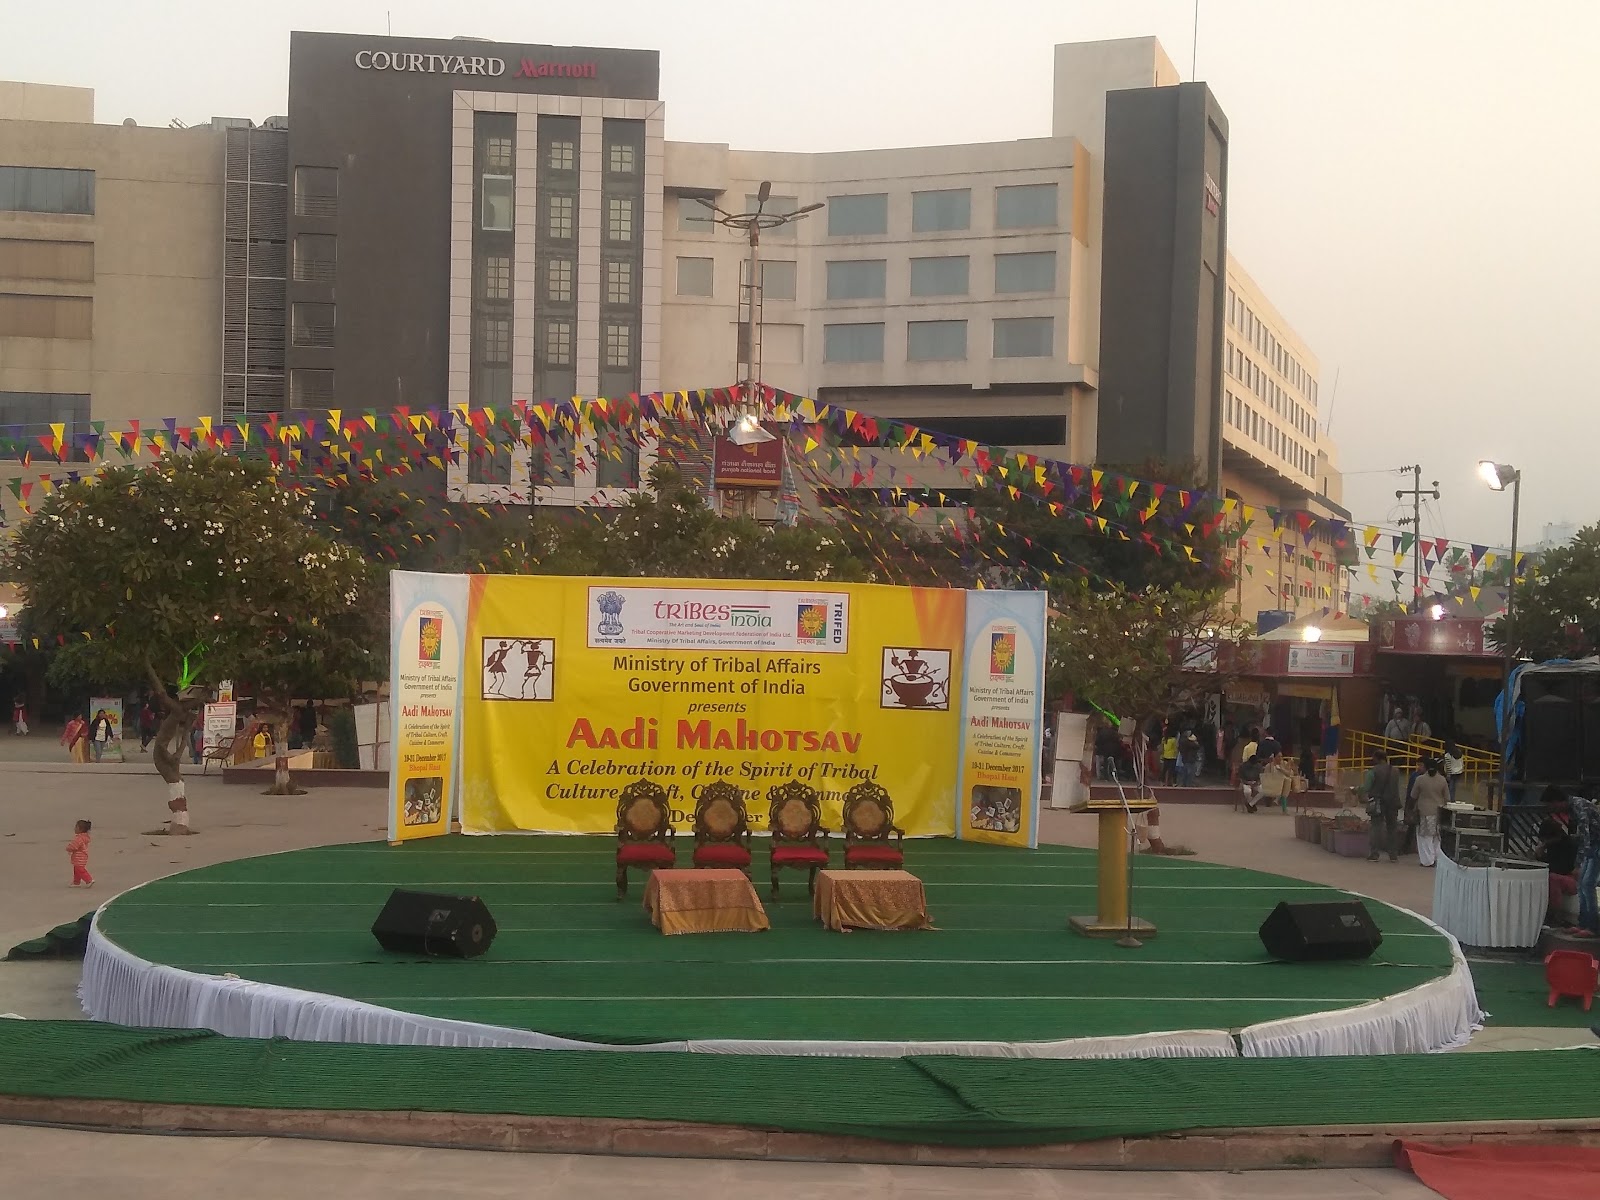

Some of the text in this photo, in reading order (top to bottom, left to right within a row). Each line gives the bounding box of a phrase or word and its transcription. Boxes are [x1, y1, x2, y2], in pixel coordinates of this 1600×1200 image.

[355, 50, 506, 77] COURTYARD
[513, 57, 597, 79] Marriott
[833, 602, 843, 644] TRIFED
[613, 654, 821, 676] Ministry of Tribal Affairs
[628, 677, 805, 695] Government of India
[969, 686, 992, 695] Ministry
[1015, 688, 1035, 697] Affairs
[687, 701, 747, 715] presents
[973, 694, 1007, 703] Government
[545, 759, 879, 781] A Celebration of the Spirit of Tribal
[985, 762, 1012, 773] December
[1011, 764, 1025, 774] 2017
